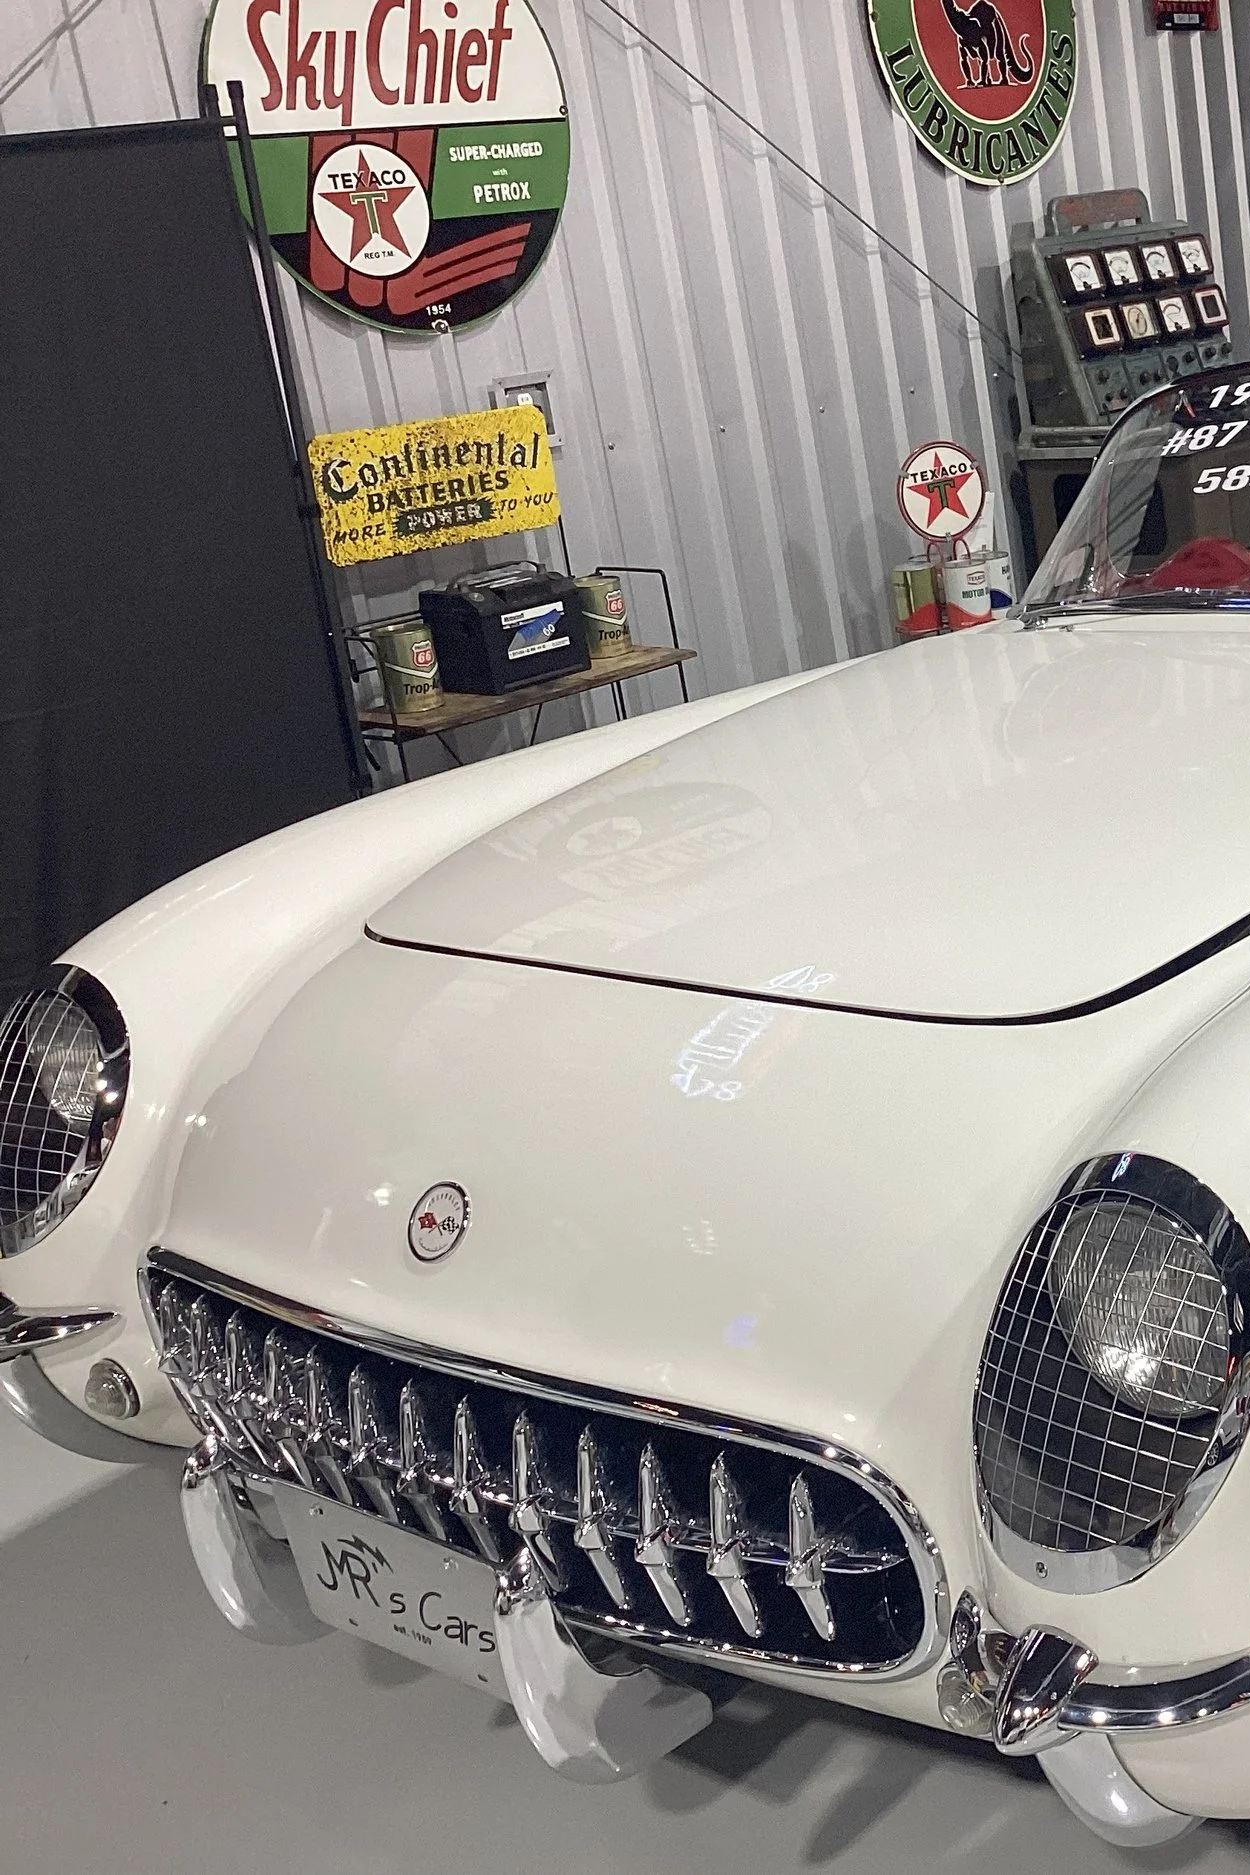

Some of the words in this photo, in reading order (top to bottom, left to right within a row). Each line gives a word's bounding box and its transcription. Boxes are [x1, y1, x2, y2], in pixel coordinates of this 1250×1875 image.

[246, 0, 357, 126] Sky
[366, 0, 513, 105] Chief
[885, 30, 1074, 175] LUBRICANTES
[449, 142, 543, 161] SUPER-CHARGED
[327, 169, 406, 190] TEXACO
[492, 168, 508, 176] with
[473, 182, 531, 203] PETROX
[426, 304, 452, 316] 1954
[1160, 419, 1245, 458] #87
[322, 431, 541, 503] Continental
[910, 462, 968, 484] TEXACO
[366, 470, 510, 515] BATTERIES
[333, 525, 387, 545] MORE
[406, 503, 484, 531] POWER
[501, 498, 518, 512] TO
[524, 492, 554, 509] YOU
[610, 599, 623, 611] 66
[542, 623, 556, 637] 60
[417, 650, 432, 663] 66
[419, 1591, 496, 1653] Cars
